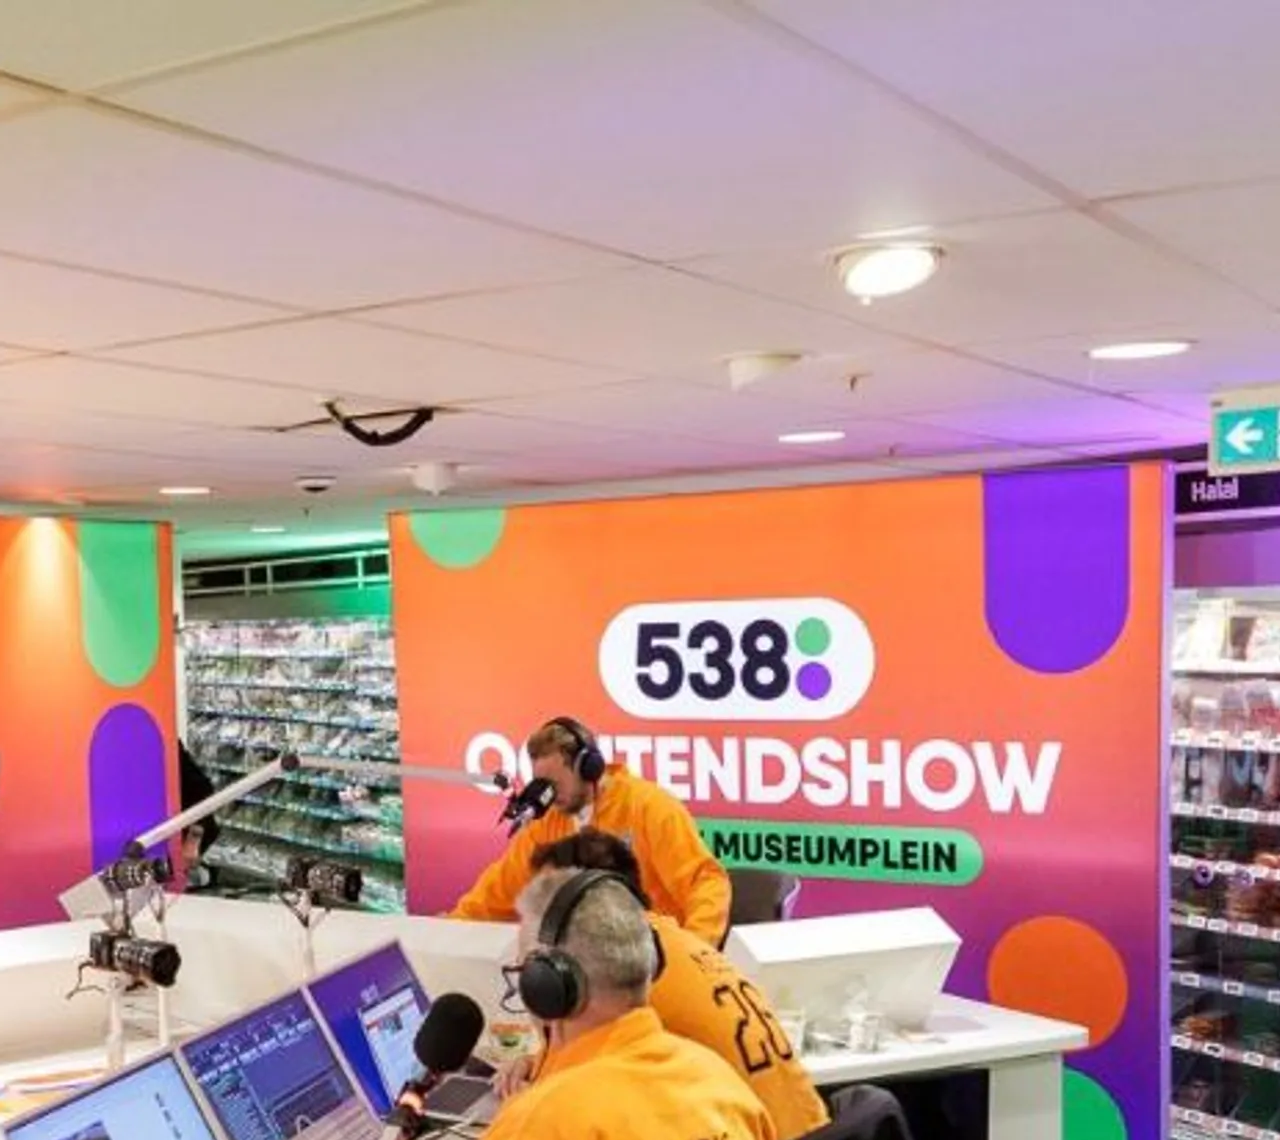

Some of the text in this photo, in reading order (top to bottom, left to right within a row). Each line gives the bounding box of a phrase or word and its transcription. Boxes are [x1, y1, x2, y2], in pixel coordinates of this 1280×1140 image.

[1191, 477, 1239, 501] Halal
[634, 618, 790, 701] 538
[465, 731, 1061, 815] OTENDSHOW
[714, 832, 957, 873] MUSEUMPLEIN
